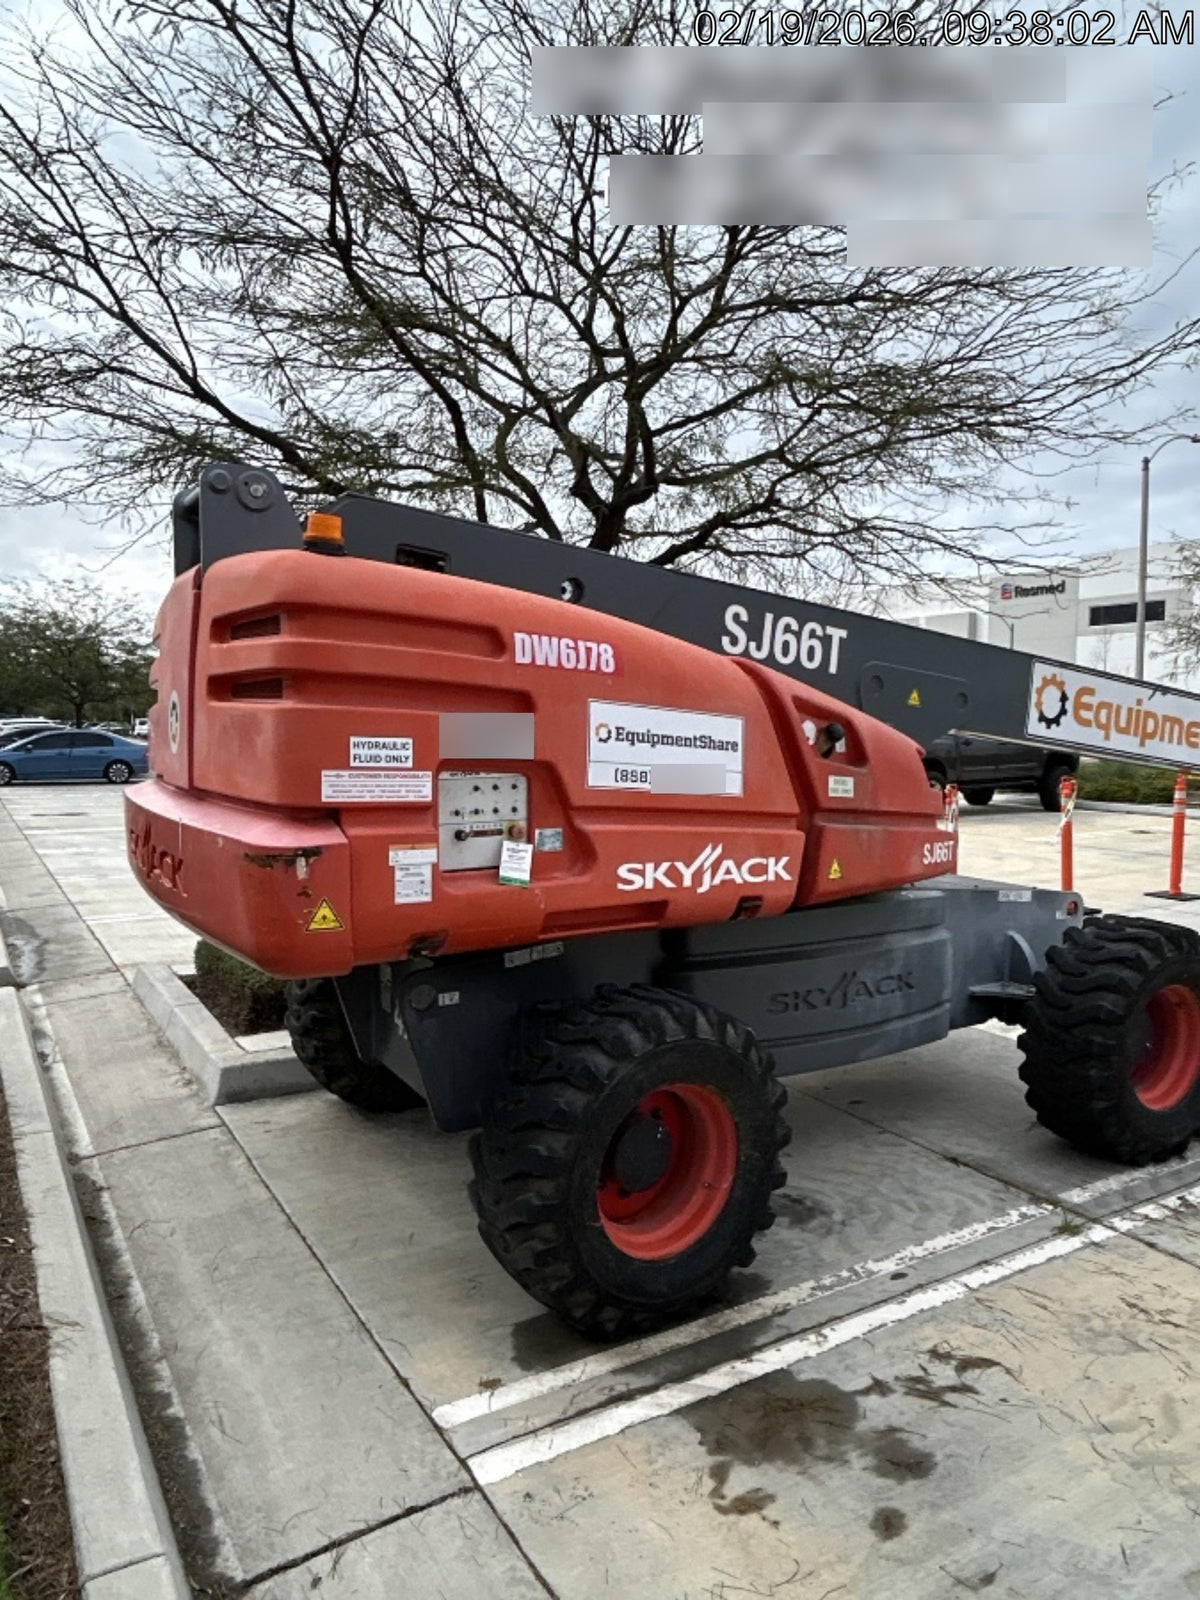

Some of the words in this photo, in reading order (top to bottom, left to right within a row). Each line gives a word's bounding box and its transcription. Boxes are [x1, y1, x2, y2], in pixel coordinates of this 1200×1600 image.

[513, 632, 615, 673] DW6J78
[721, 604, 847, 675] SJ66T
[352, 740, 410, 751] HYDRAULIC
[614, 726, 739, 753] EquipmentShare
[353, 753, 382, 763] FLUID
[384, 755, 410, 764] ONLY
[616, 843, 793, 894] SKYJACK
[922, 840, 955, 865] SJ66T
[767, 971, 915, 1014] SKYJACK
